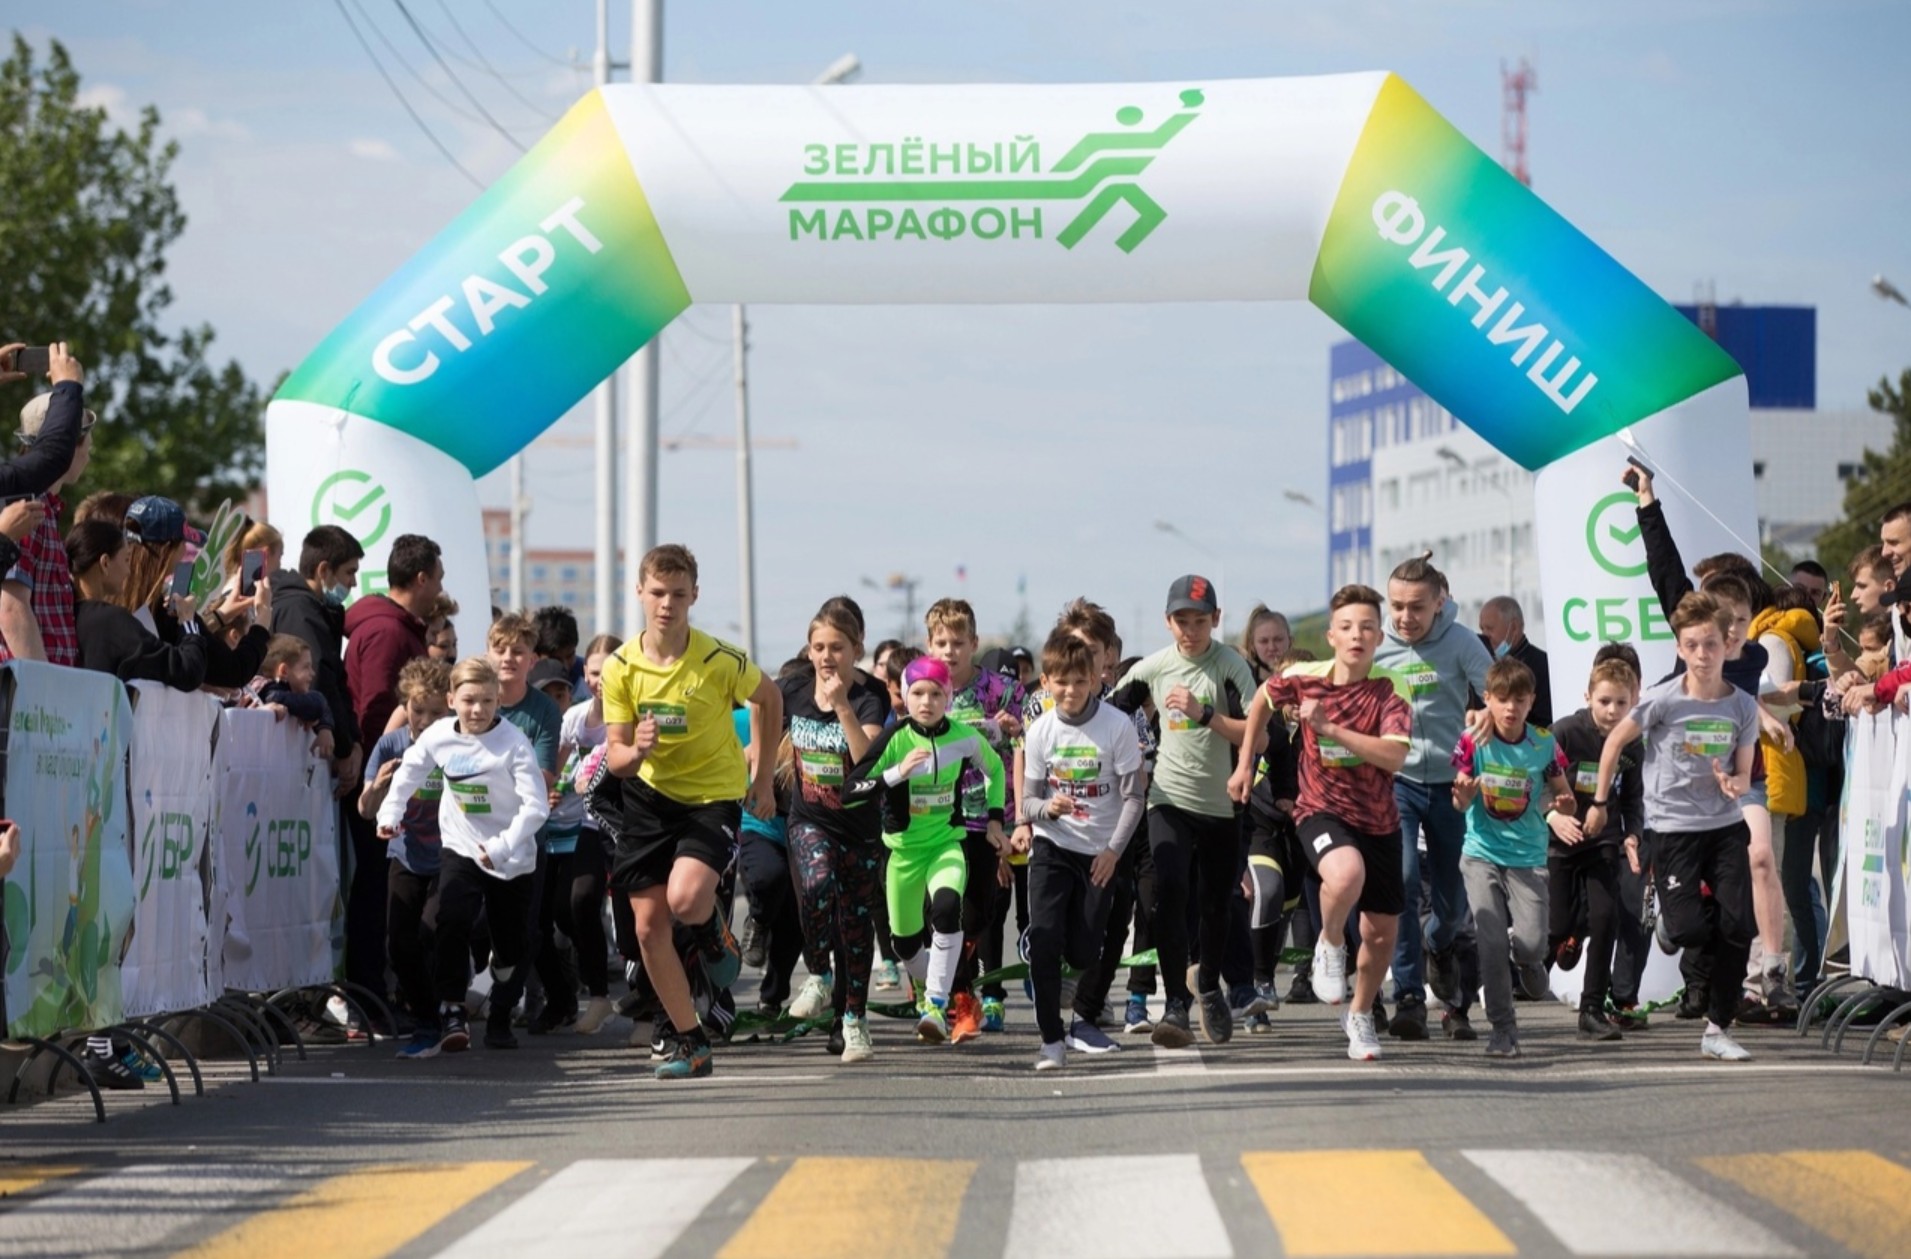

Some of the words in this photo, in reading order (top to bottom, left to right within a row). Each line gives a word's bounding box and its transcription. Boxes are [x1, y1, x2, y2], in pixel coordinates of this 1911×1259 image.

[804, 134, 1041, 176] ЗЕЛЁНЫЙ
[788, 206, 1043, 241] МАРАФОН
[371, 196, 604, 385] СТАРТ
[1372, 190, 1599, 415] ФИНИШ
[1562, 597, 1675, 642] СБЕ
[821, 765, 839, 774] 030
